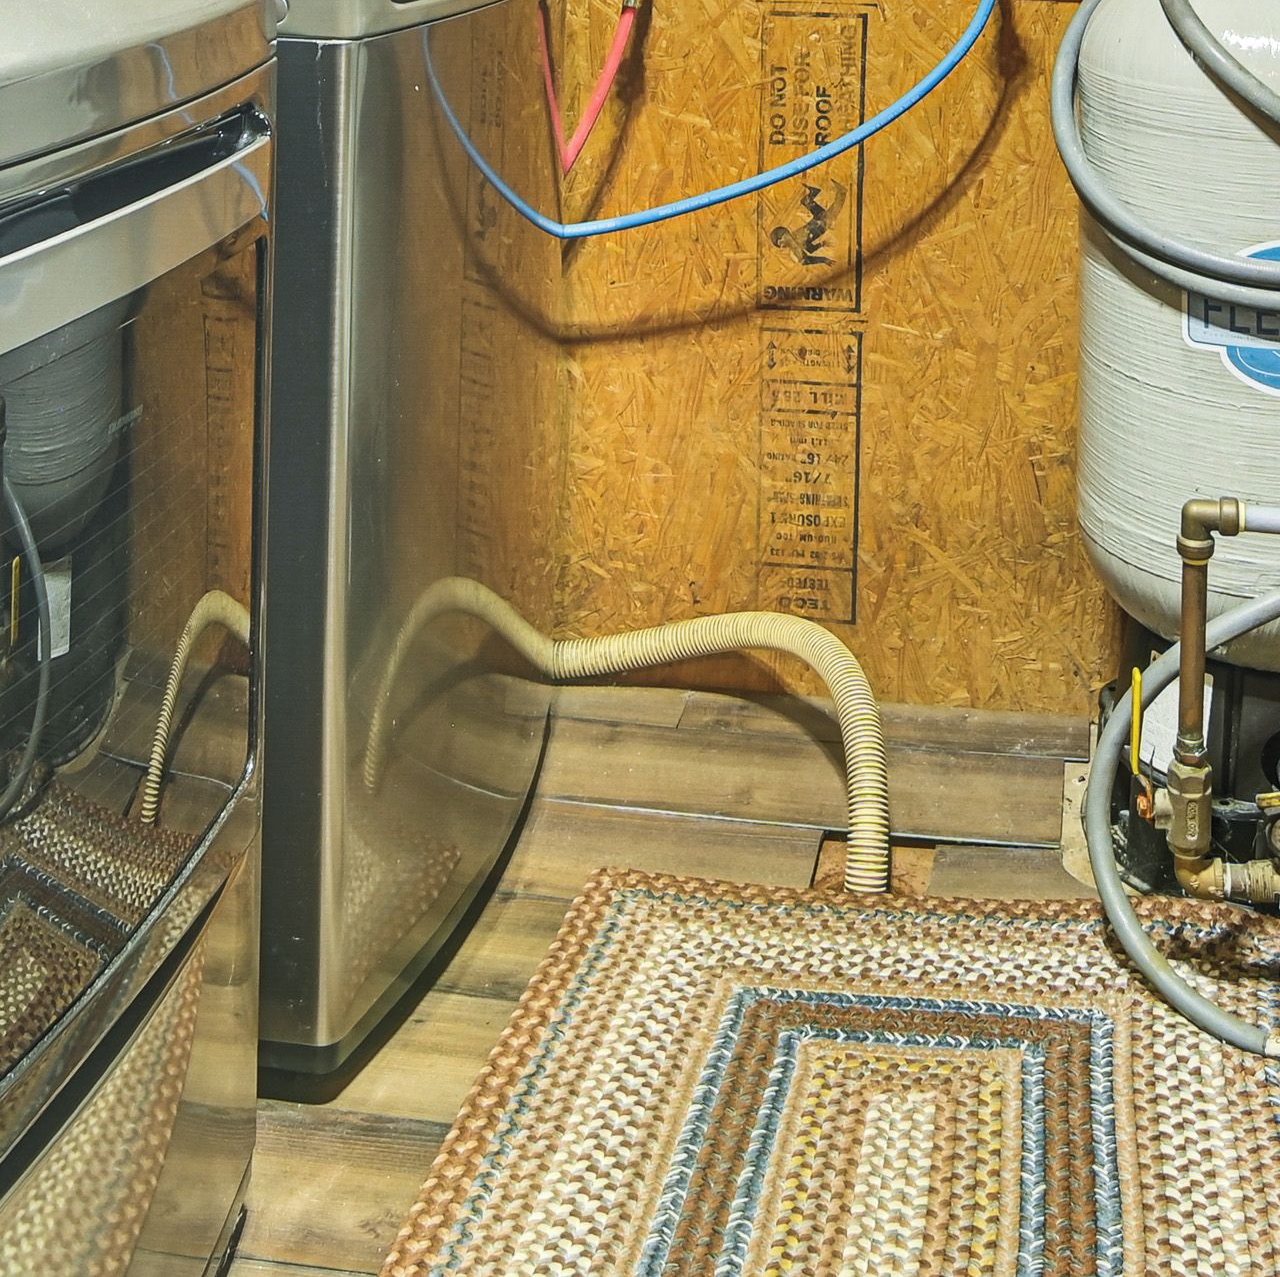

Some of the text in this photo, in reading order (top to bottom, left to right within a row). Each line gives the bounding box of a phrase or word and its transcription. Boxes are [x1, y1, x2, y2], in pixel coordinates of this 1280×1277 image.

[769, 66, 788, 146] DO NOT
[792, 50, 811, 146] USE FOR
[836, 24, 857, 134] HEATHING
[815, 85, 833, 148] ROOF
[763, 285, 854, 303] WARNING
[769, 511, 847, 529] EXPOSURE 1
[787, 576, 830, 591] TESTED
